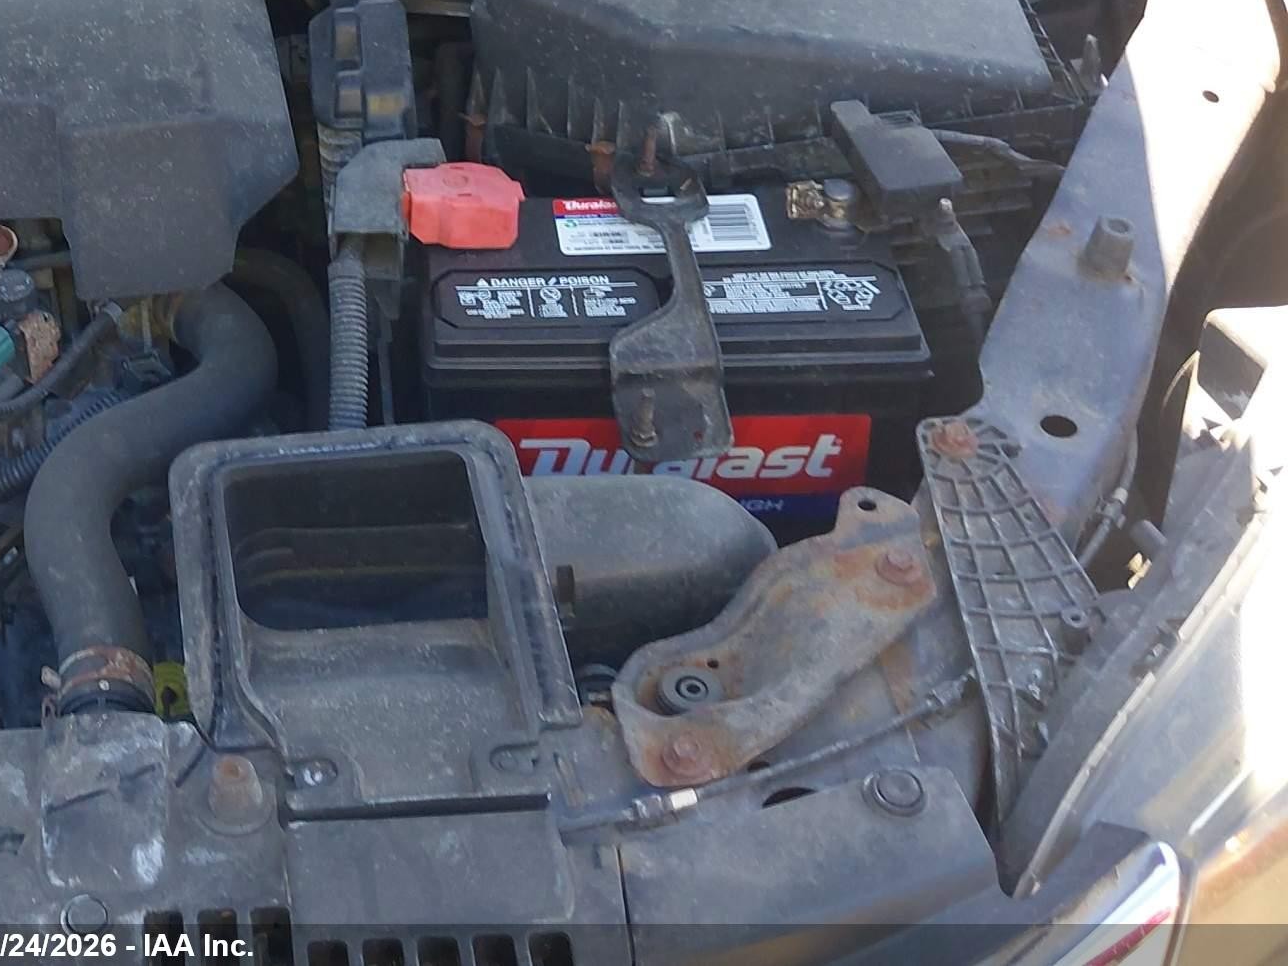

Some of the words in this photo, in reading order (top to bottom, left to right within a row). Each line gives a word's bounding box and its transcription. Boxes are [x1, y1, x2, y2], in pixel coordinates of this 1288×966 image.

[563, 199, 618, 211] Duralas
[490, 277, 546, 287] DANGER
[559, 275, 610, 286] POISON
[519, 434, 842, 480] Duaast
